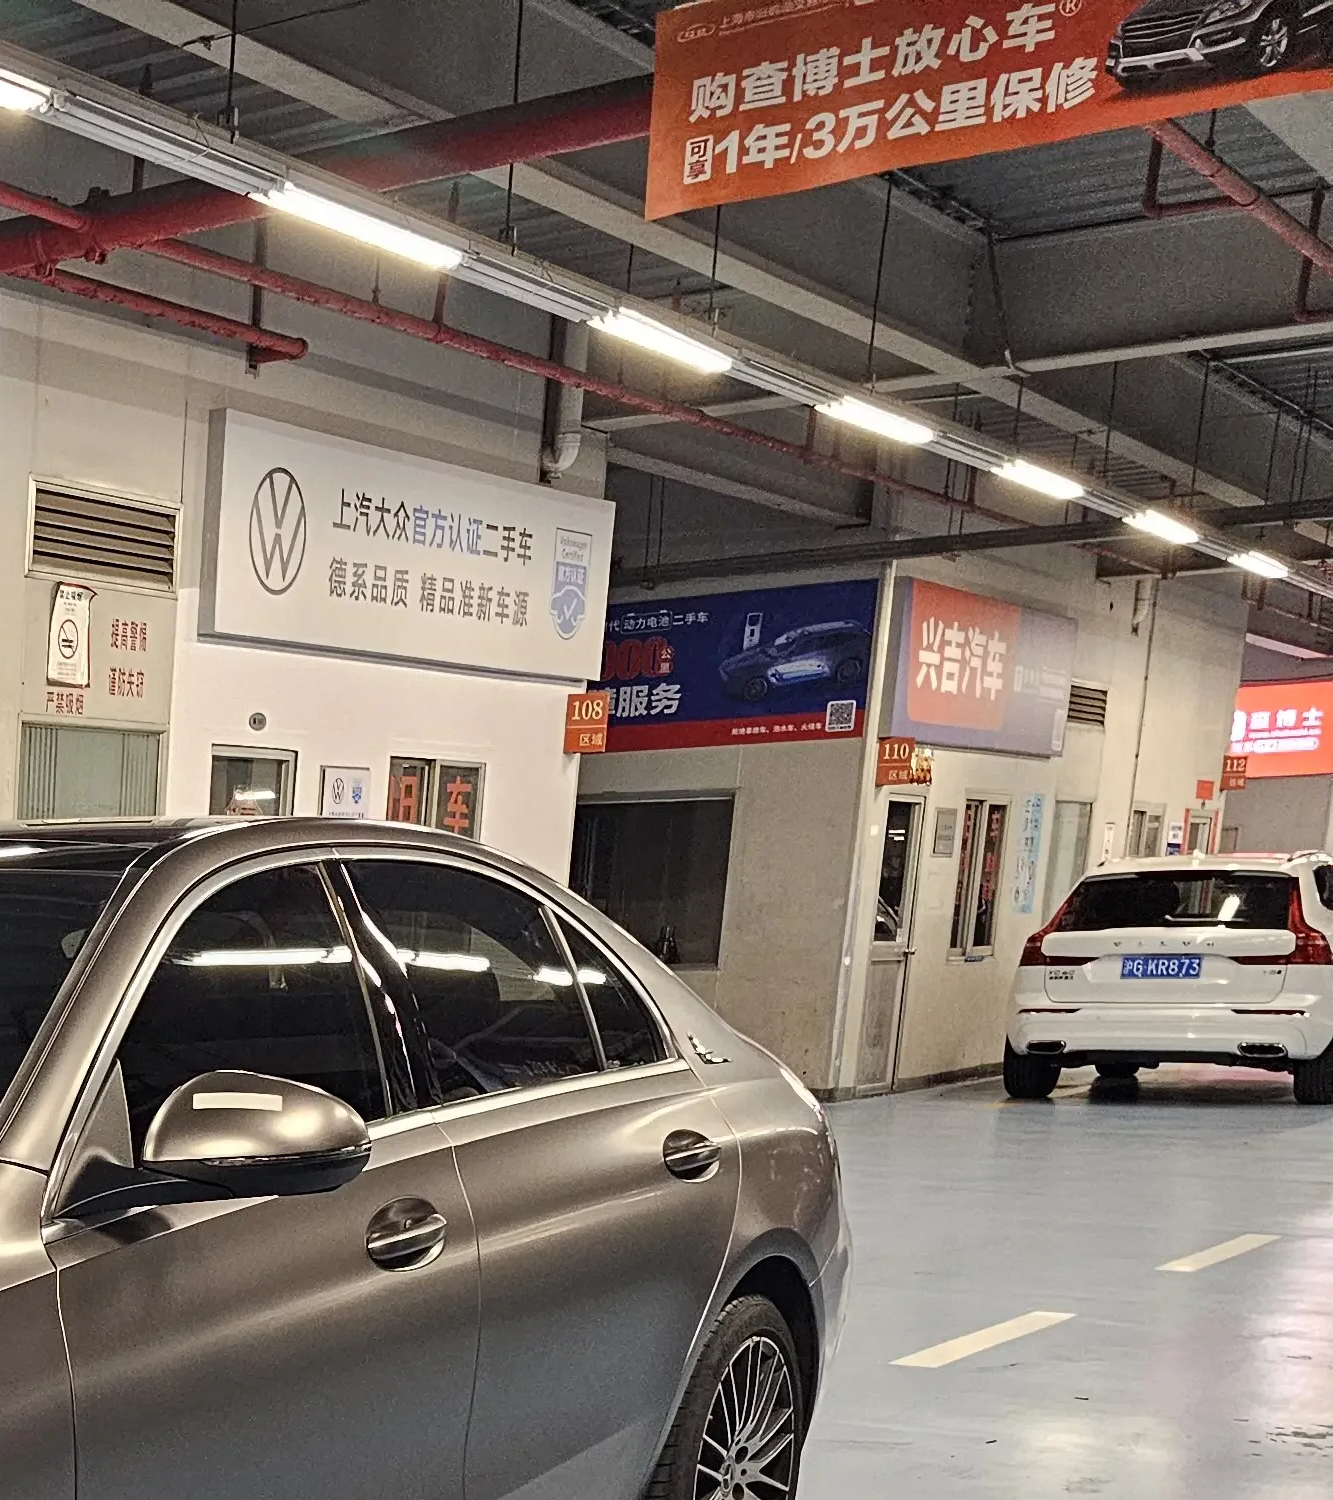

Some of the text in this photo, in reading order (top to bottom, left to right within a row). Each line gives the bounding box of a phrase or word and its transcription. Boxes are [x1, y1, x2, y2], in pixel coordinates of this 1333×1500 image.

[688, 2, 1058, 123] 购查博士放心车
[713, 57, 1099, 174] 1年/3万公里保修
[687, 138, 709, 181] 可享
[333, 488, 533, 566] 上汽大众官方认证二手车
[328, 556, 530, 628] 德系品质 精品准新车源
[110, 617, 147, 652] 提高警惕
[603, 611, 709, 633] 代动力电池二手车
[915, 616, 1007, 701] 兴吉汽车
[45, 691, 84, 715] 严禁吸烟
[571, 699, 604, 721] 108
[579, 733, 603, 747] 区域
[882, 743, 909, 760] 110
[888, 769, 911, 781] 区域
[1225, 758, 1246, 771] 112
